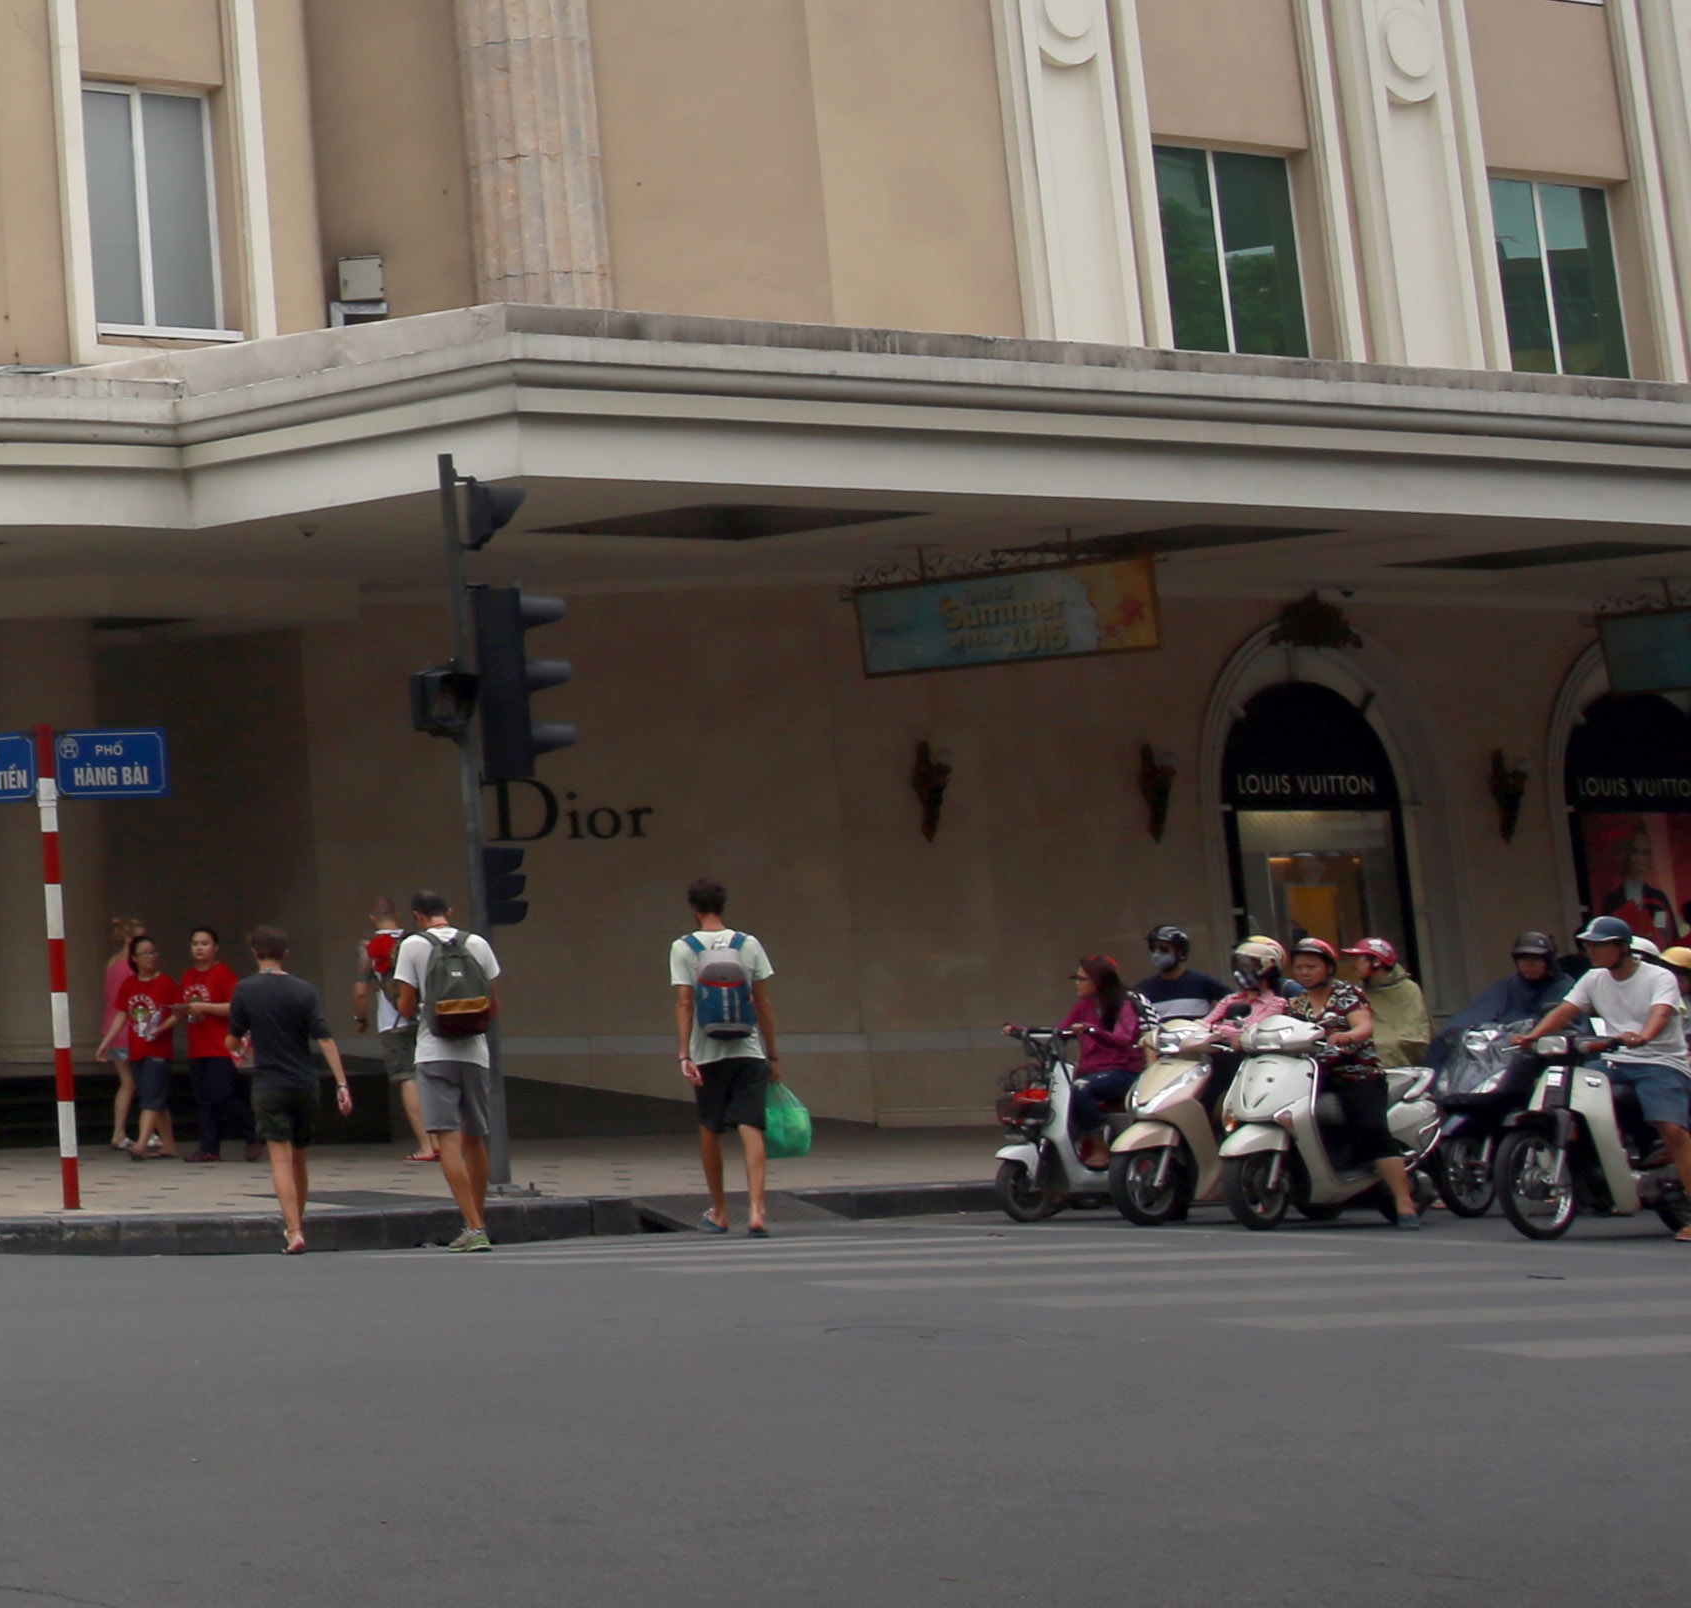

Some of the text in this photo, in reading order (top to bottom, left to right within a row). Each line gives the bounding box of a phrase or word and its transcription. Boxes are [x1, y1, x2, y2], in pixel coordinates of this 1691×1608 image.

[939, 595, 1067, 631] Summer
[1003, 621, 1070, 654] 2016
[95, 740, 123, 757] PHỐ
[73, 761, 149, 787] HÀNG BÀI
[1236, 774, 1375, 795] LOUIS VUITTON
[1578, 776, 1628, 797] LOUIS
[483, 777, 653, 843] Dior
